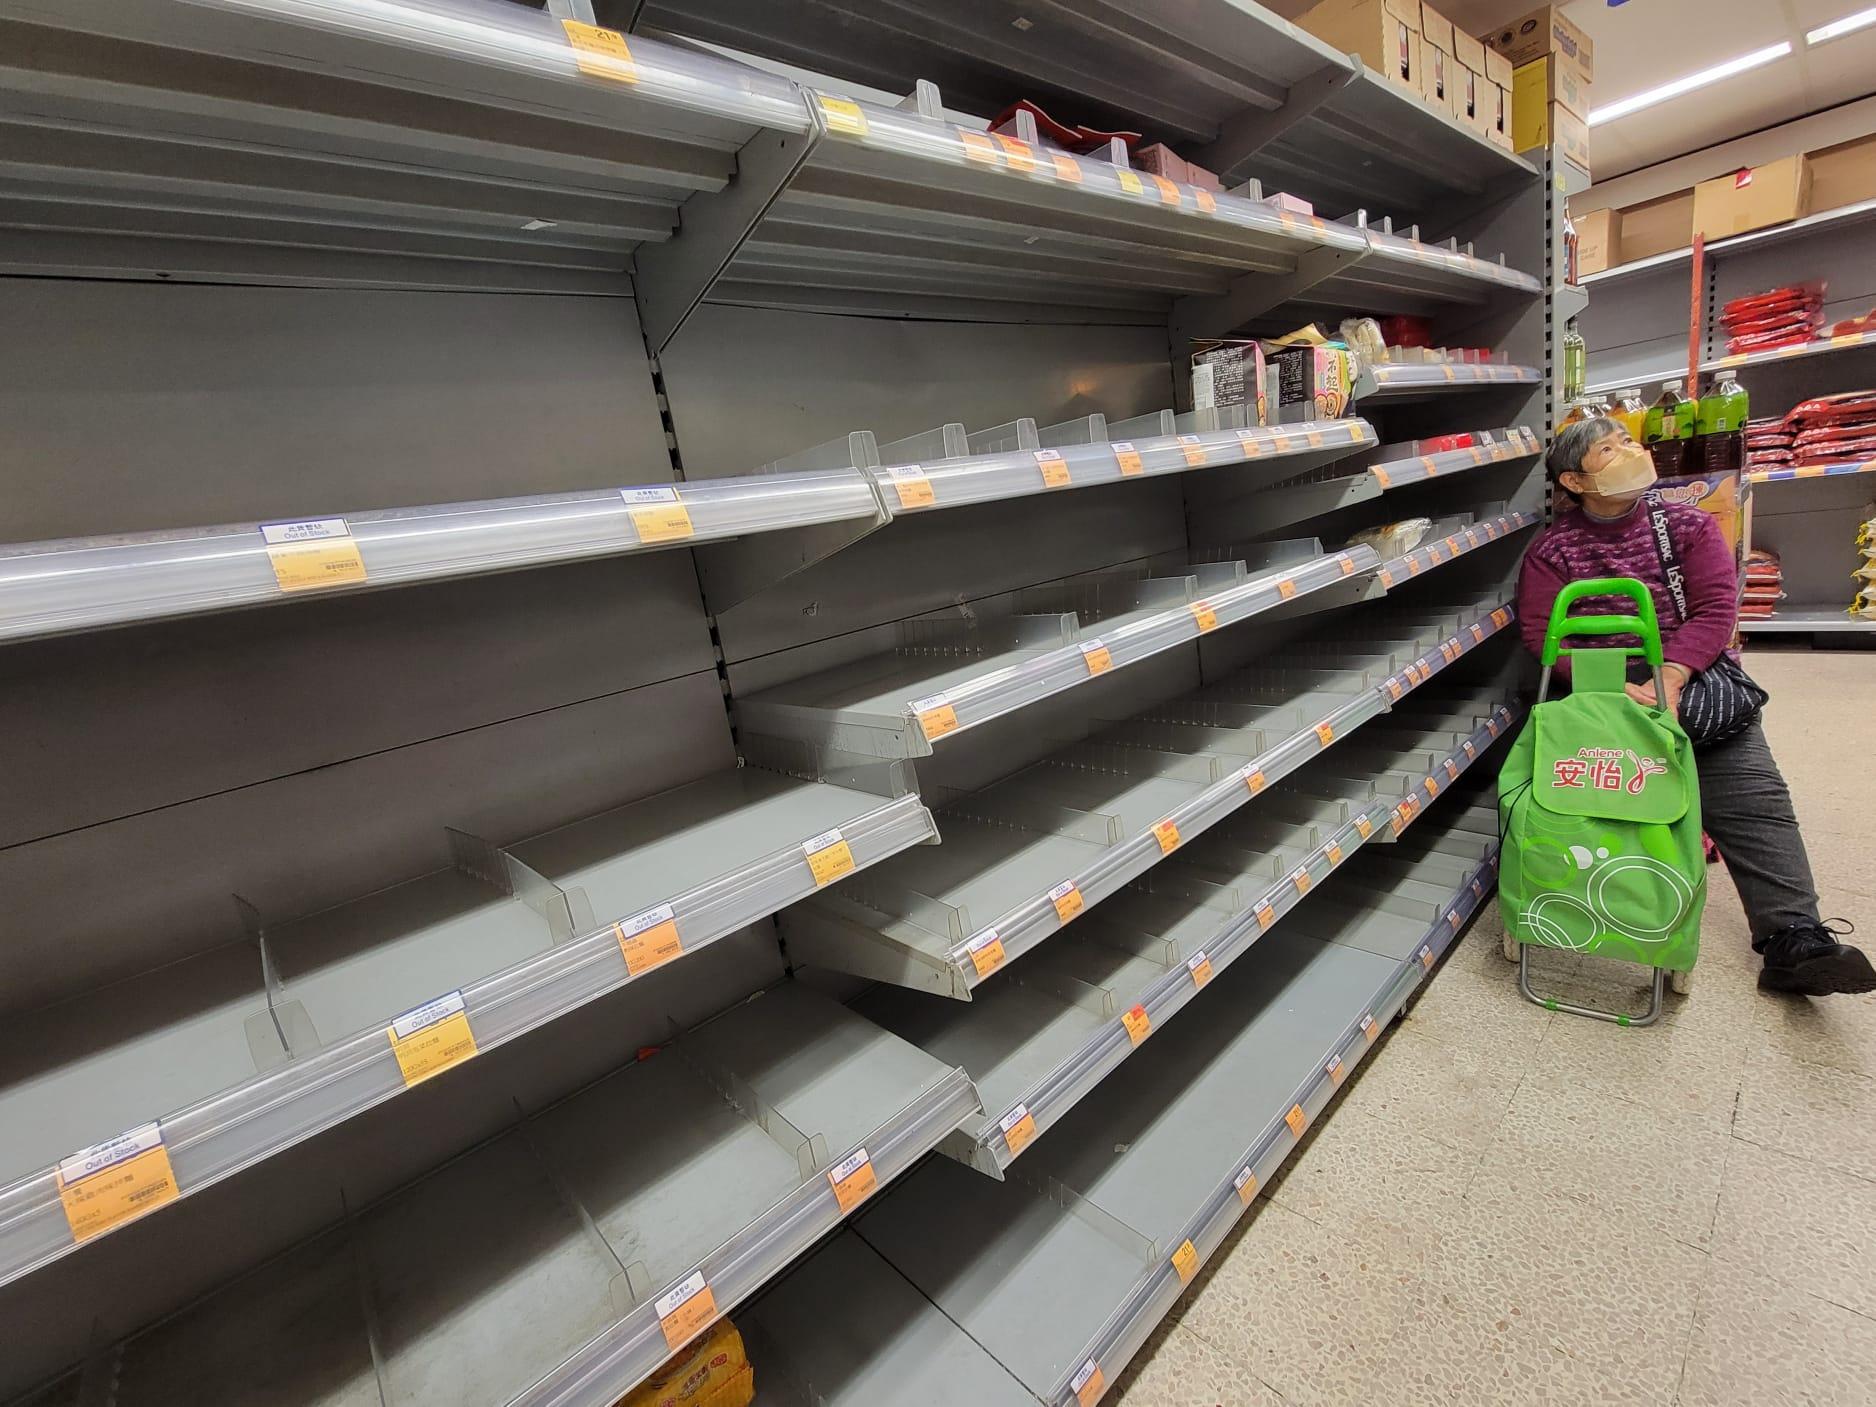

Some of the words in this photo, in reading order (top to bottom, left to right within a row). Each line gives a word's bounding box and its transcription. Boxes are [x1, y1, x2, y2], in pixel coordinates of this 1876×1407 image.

[309, 529, 330, 537] Stock
[1578, 748, 1624, 759] Anlene
[1552, 758, 1623, 790] 安怡
[650, 915, 663, 924] Stock
[412, 1018, 424, 1028] Out
[431, 1007, 449, 1019] Stock
[85, 1158, 102, 1170] Out
[103, 1154, 113, 1163] of
[114, 1143, 141, 1158] Stock
